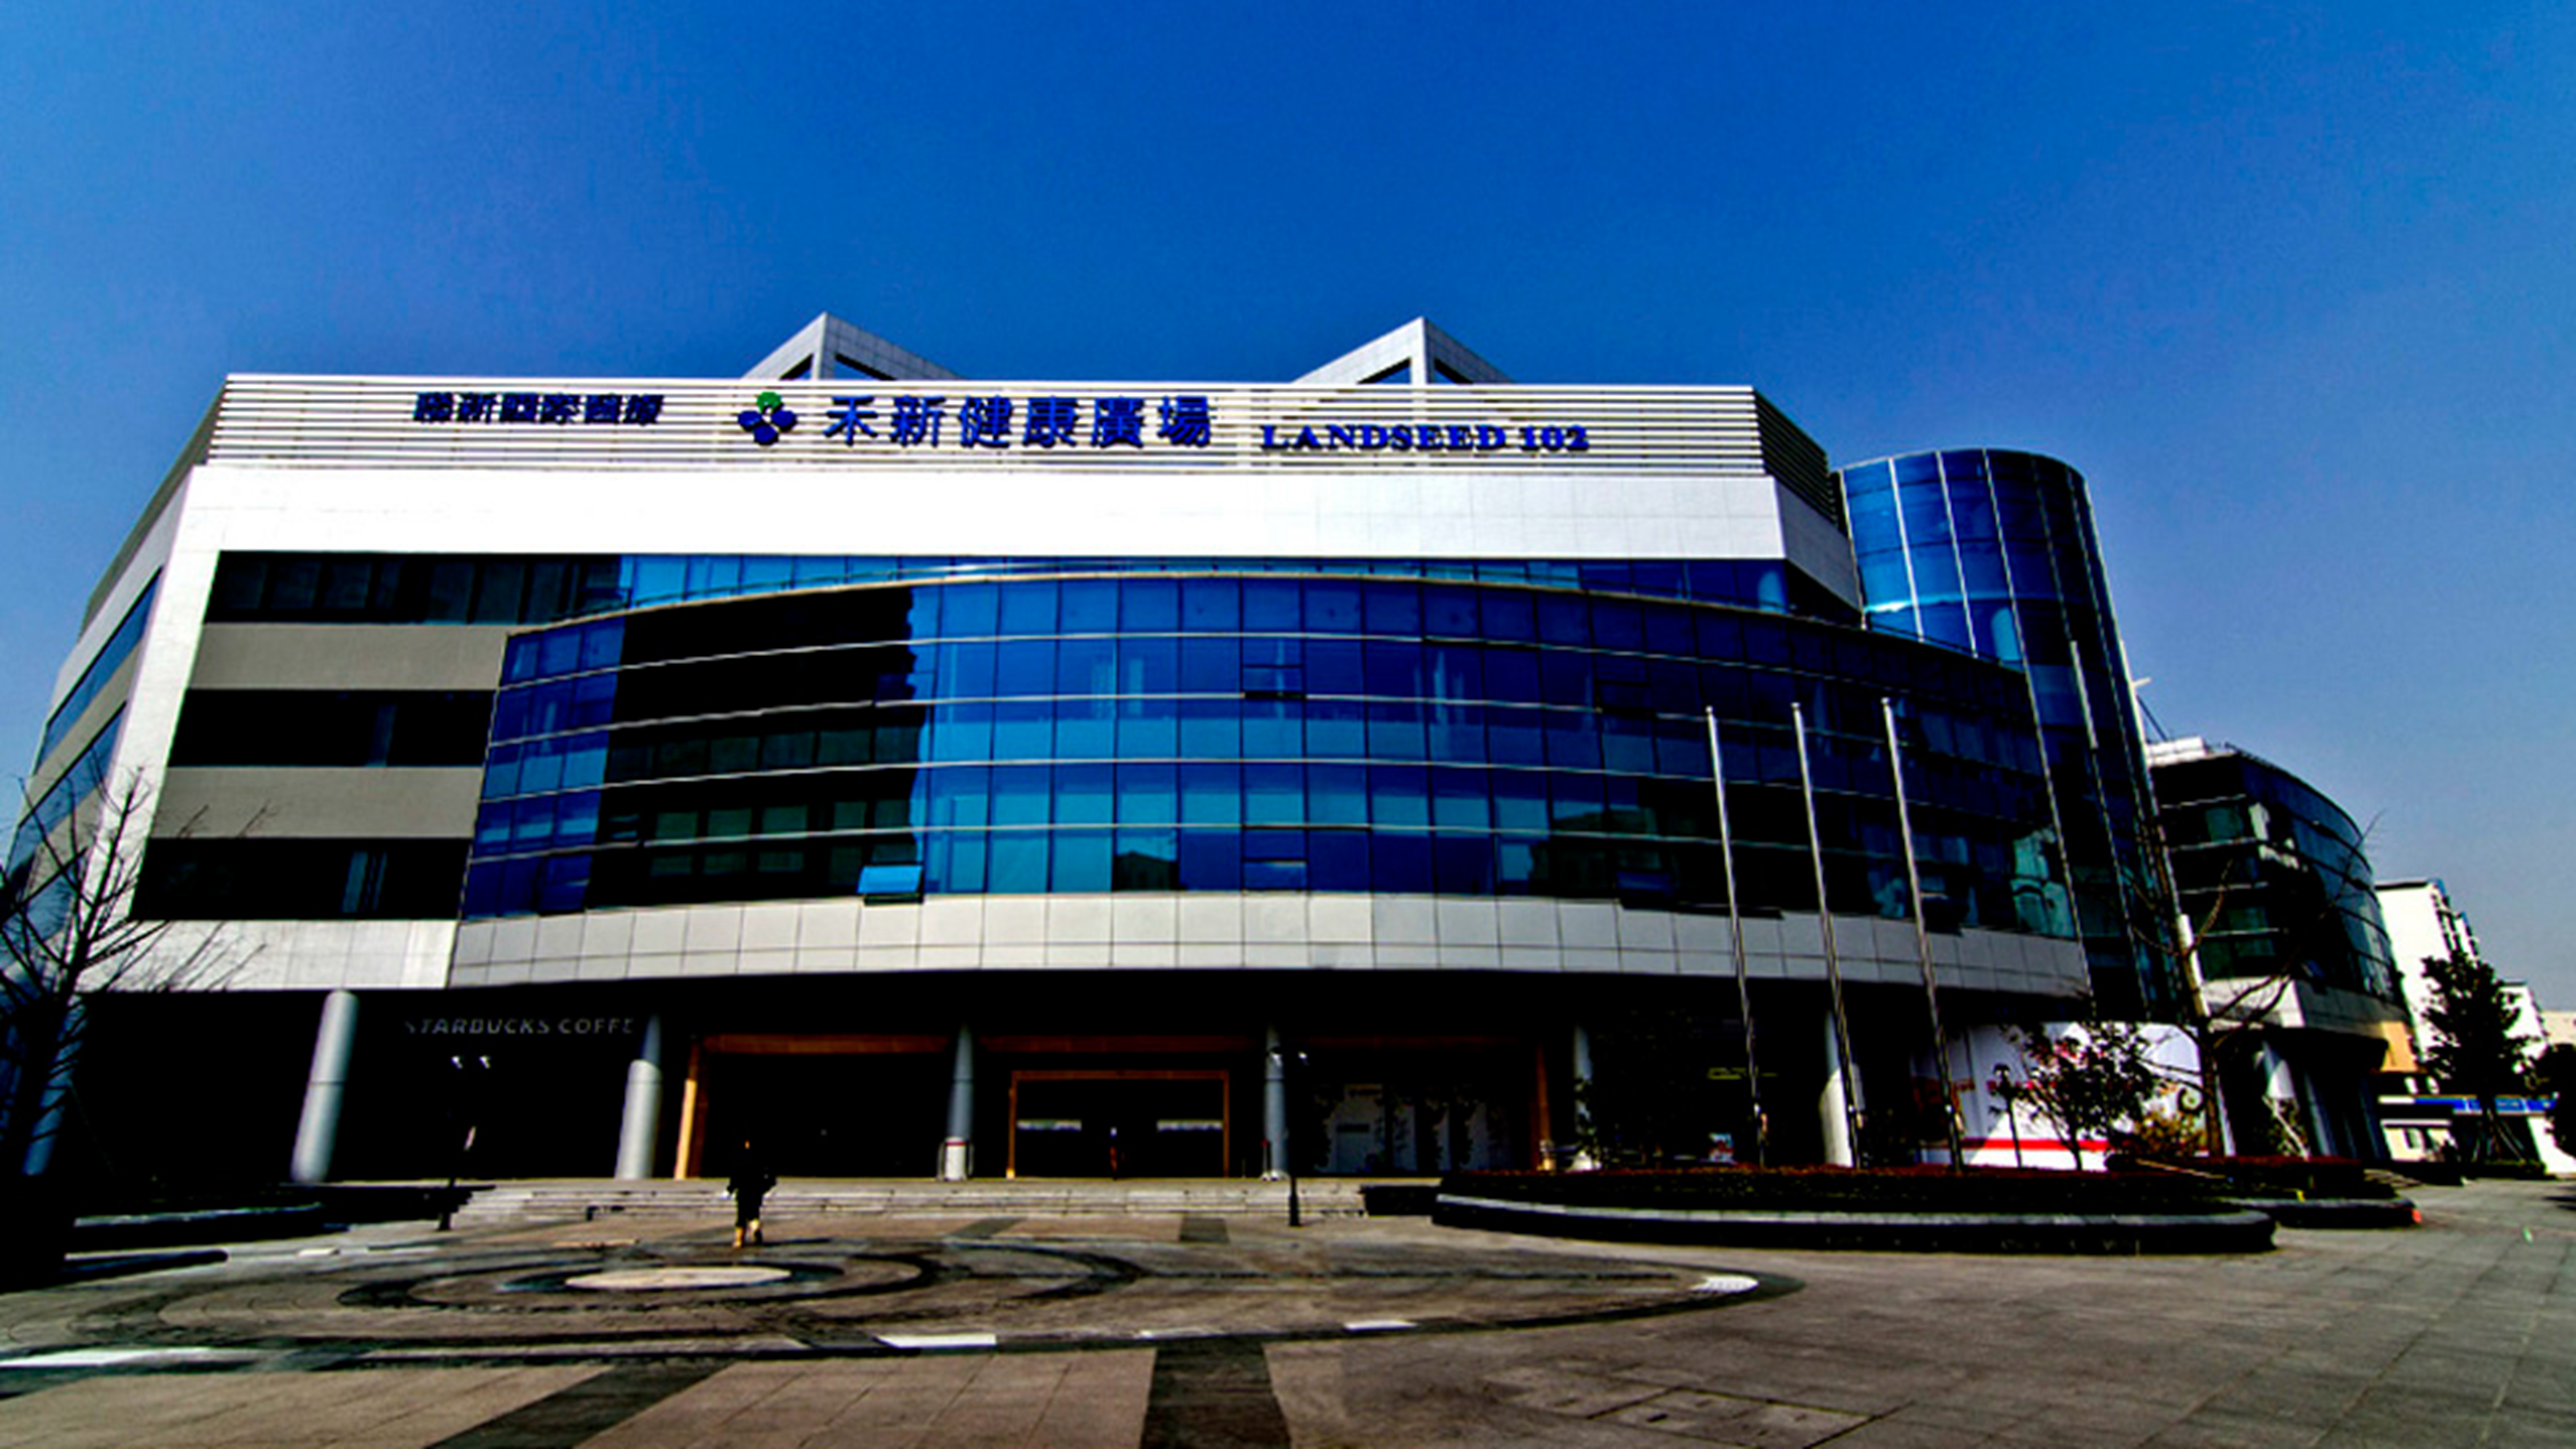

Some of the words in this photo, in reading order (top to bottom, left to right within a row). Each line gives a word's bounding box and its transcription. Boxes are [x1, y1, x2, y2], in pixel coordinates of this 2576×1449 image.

[823, 395, 1212, 448] 禾新健康廣場
[1259, 423, 1508, 451] LANDSEED
[1519, 424, 1590, 451] 102
[404, 1018, 551, 1034] STARBUCKS
